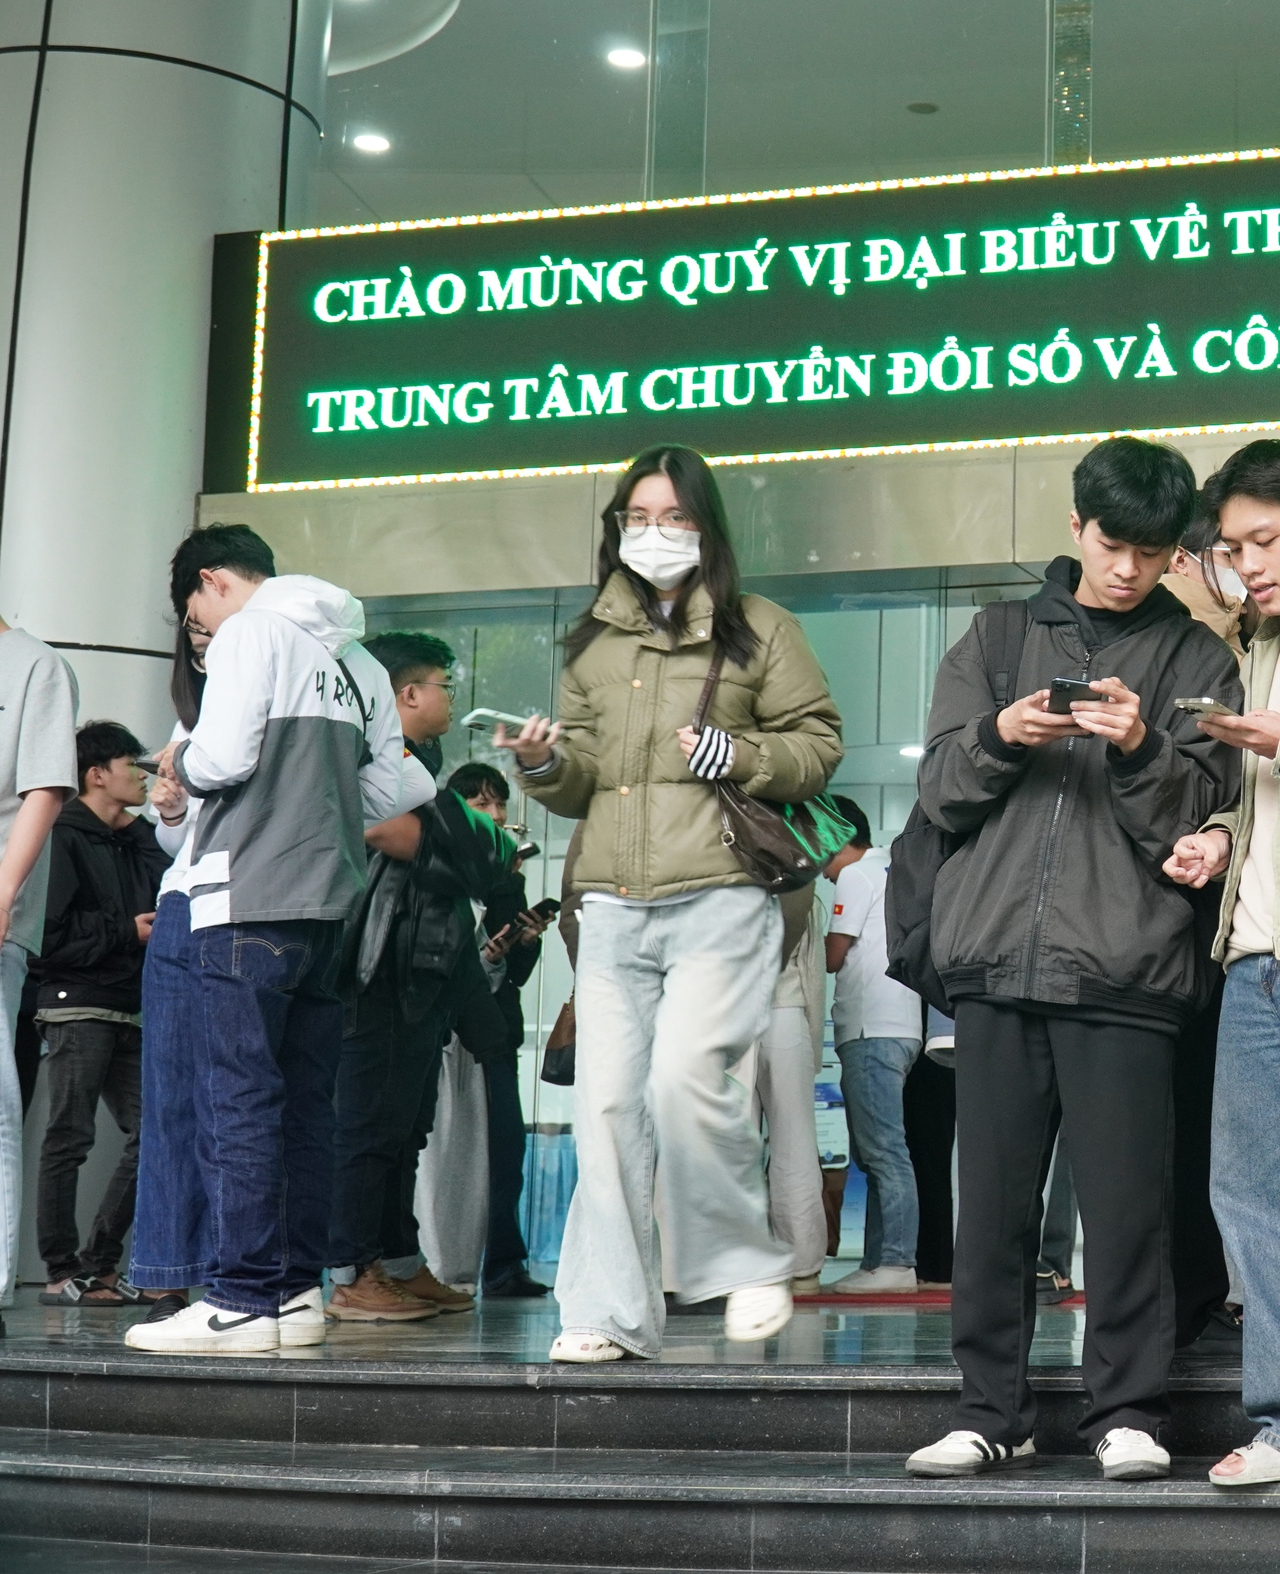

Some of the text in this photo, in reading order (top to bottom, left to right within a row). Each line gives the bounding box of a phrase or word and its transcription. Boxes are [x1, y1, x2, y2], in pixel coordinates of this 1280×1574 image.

[314, 266, 466, 323] CHÀO
[477, 255, 648, 312] MỪNG
[660, 238, 778, 306] QUÝ
[789, 239, 851, 296] VỊ
[862, 233, 967, 289] ĐẠI
[979, 211, 1120, 273] BIỂU
[1130, 202, 1210, 263] VỀ
[307, 381, 494, 433] TRUNG
[504, 364, 629, 421] TÂM
[640, 345, 876, 411] CHUYỂN
[886, 336, 994, 395] ĐỔI
[1008, 327, 1083, 387] SỐ
[1093, 323, 1178, 380] VÀ
